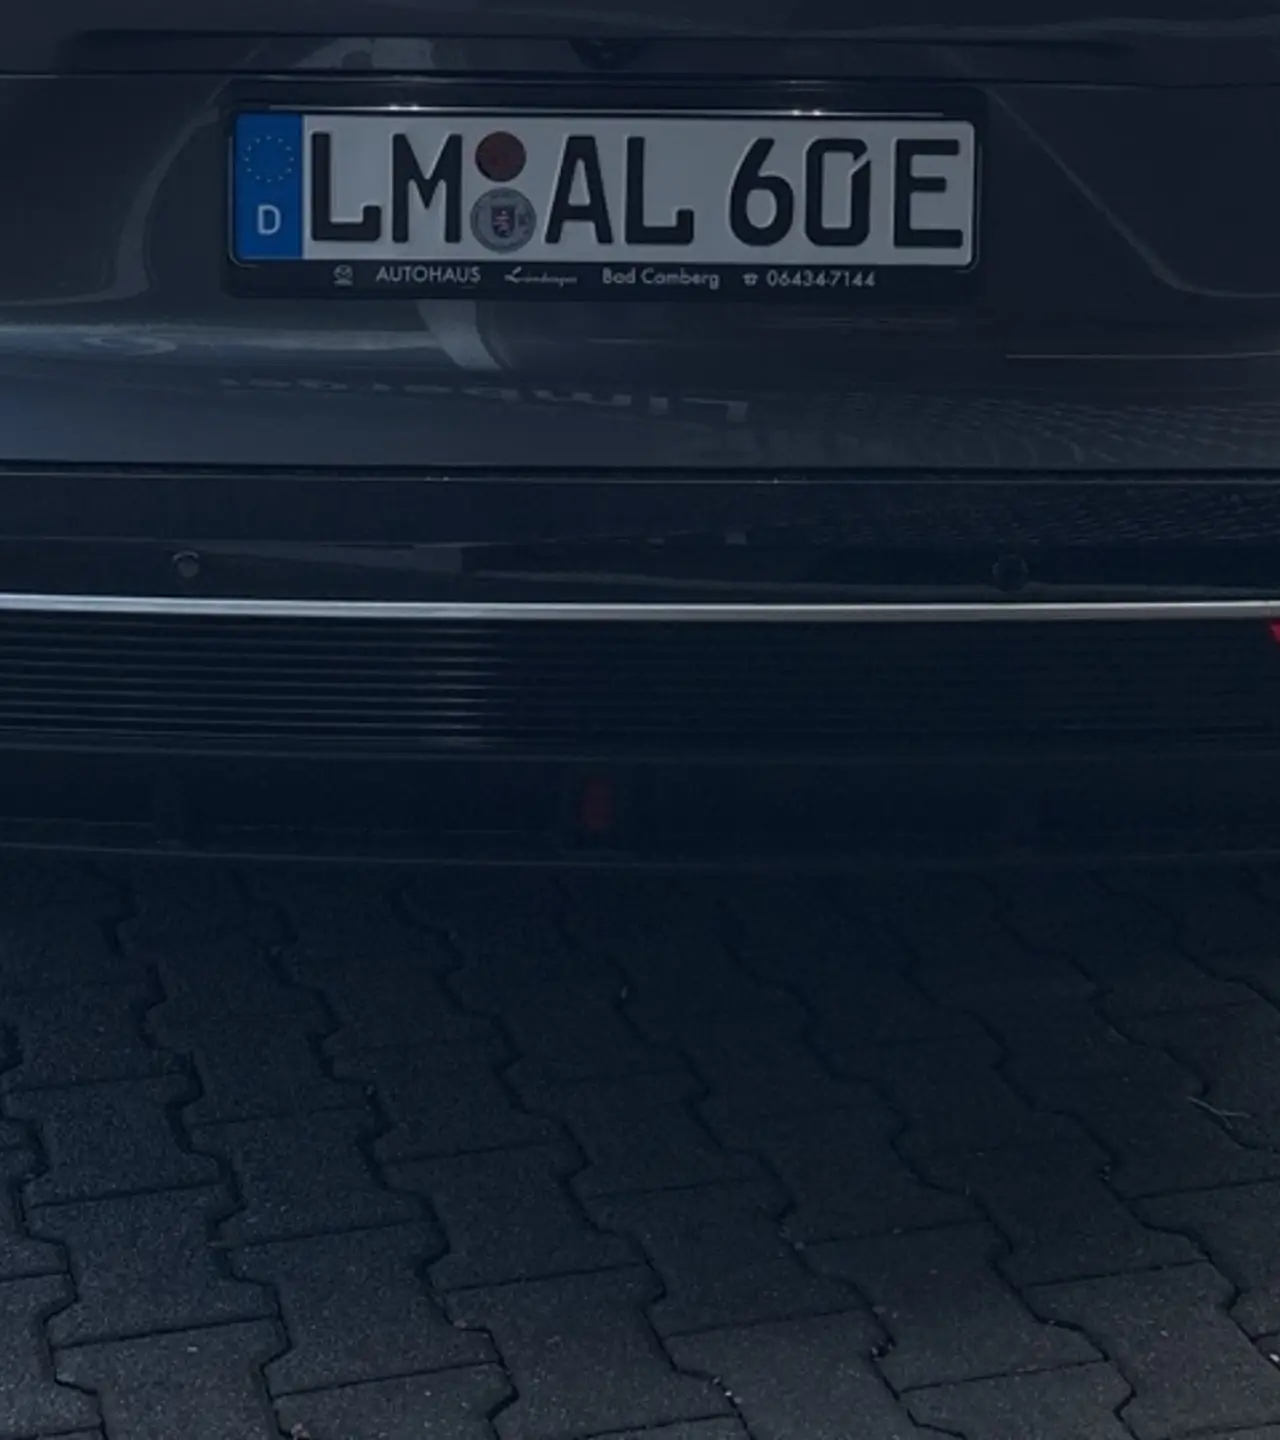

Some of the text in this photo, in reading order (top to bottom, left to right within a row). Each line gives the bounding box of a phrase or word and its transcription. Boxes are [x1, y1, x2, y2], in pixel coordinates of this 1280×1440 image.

[310, 132, 964, 249] LM AL 60E
[257, 204, 282, 236] D
[375, 265, 482, 285] AUTOHAUS
[601, 267, 636, 285] Bad
[639, 268, 720, 290] Camberg
